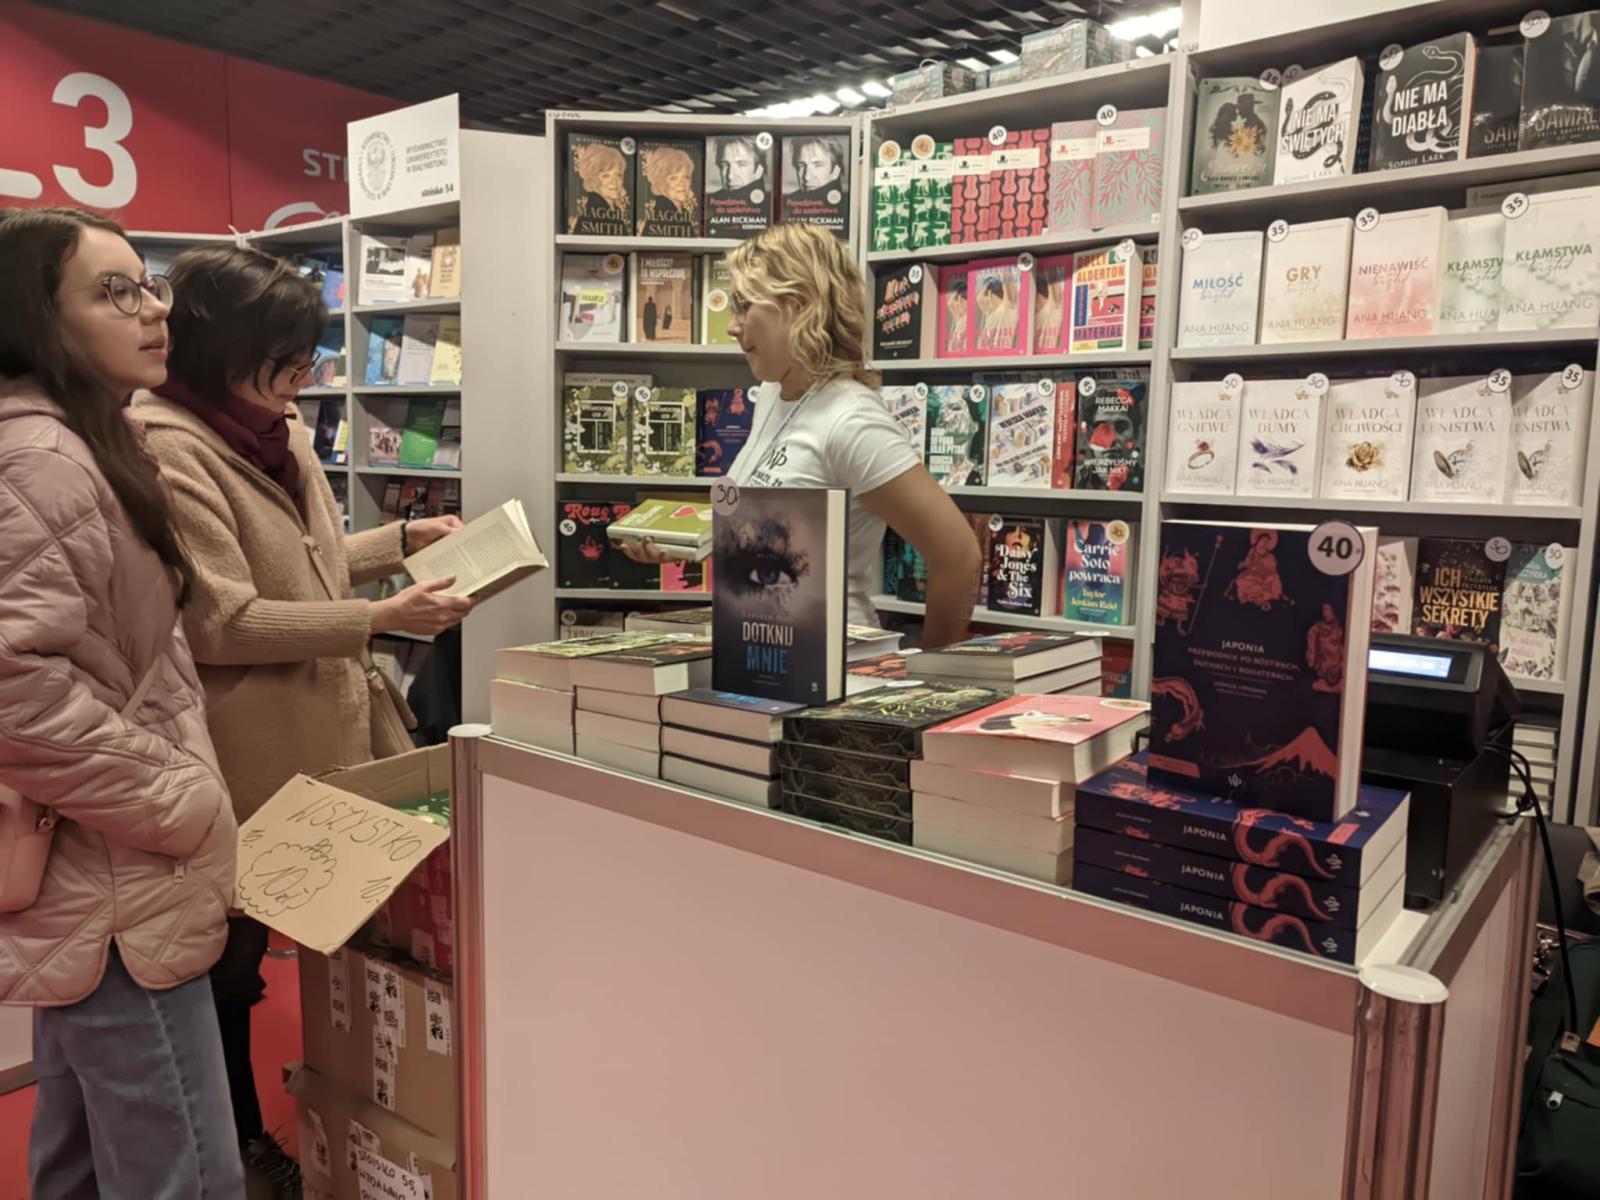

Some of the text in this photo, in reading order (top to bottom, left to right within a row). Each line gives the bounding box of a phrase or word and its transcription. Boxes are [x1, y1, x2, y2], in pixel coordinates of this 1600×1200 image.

[1263, 72, 1279, 85] 35
[1394, 80, 1448, 112] NIE MA
[1100, 109, 1114, 121] 40
[1294, 103, 1338, 128] NIE MA
[1391, 106, 1448, 137] DIABŁA
[992, 129, 1004, 142] 40
[1388, 153, 1444, 169] SOPHIE LARK
[578, 206, 628, 220] MAGGIE
[1505, 197, 1524, 214] 35
[710, 216, 767, 224] ALAN RICKMAN
[1359, 211, 1376, 227] 35
[581, 221, 624, 235] SMITH
[649, 224, 691, 237] SMITH
[1271, 225, 1285, 237] 35
[1515, 243, 1593, 262] KŁAMSTWA
[1358, 256, 1430, 276] NIENAWIŚĆ
[1077, 265, 1125, 284] ALDERTON
[1192, 272, 1245, 290] MIŁOŚĆ
[1286, 265, 1322, 283] GRY
[1507, 296, 1594, 313] ANA HUANG
[1353, 308, 1427, 323] ANA HUANG
[1439, 308, 1500, 321] ANA HUA
[1183, 322, 1250, 334] ANA HUANG
[1268, 316, 1336, 330] ANA HUANG
[1307, 375, 1325, 389] 30
[1491, 372, 1508, 387] 35
[1565, 369, 1581, 384] 35
[615, 385, 626, 393] 40
[1095, 397, 1133, 405] REBECCA
[1177, 408, 1233, 420] WŁADCA
[1249, 408, 1311, 420] WŁADCA
[1335, 407, 1402, 420] WŁADCA
[1424, 406, 1495, 419] WŁADCA
[1511, 404, 1570, 418] WŁADCA
[1177, 421, 1230, 434] GNIEWU
[1257, 421, 1299, 434] DUMY
[1330, 420, 1403, 434] CHCIWOŚCI
[1421, 420, 1496, 434] LENISTWA
[1084, 459, 1137, 468] WIERZYLIŚMY
[717, 485, 739, 507] 30
[563, 503, 610, 524] Roug
[994, 543, 1039, 559] Daisy
[1073, 538, 1121, 556] Carrie
[1316, 535, 1354, 560] 40
[1000, 557, 1037, 574] Jones
[1080, 553, 1111, 570] Soto
[996, 568, 1029, 582] & The
[1068, 570, 1121, 585] powraca
[1434, 567, 1462, 588] ICH
[1007, 581, 1033, 599] Six
[1082, 588, 1107, 599] Taylor
[1071, 597, 1118, 610] Jenkins Reid
[1419, 586, 1500, 612] WSZYSTKIE
[1421, 604, 1489, 629] SEKRETY
[742, 621, 794, 647] DOTKNIJ
[1221, 639, 1265, 654] JAPONIA
[746, 645, 789, 674] MNIE
[286, 793, 422, 862] WSZYSTKO
[1182, 824, 1228, 842] JAPONIA
[1181, 863, 1226, 883] JAPONIA
[1179, 902, 1225, 922] JAPONIA
